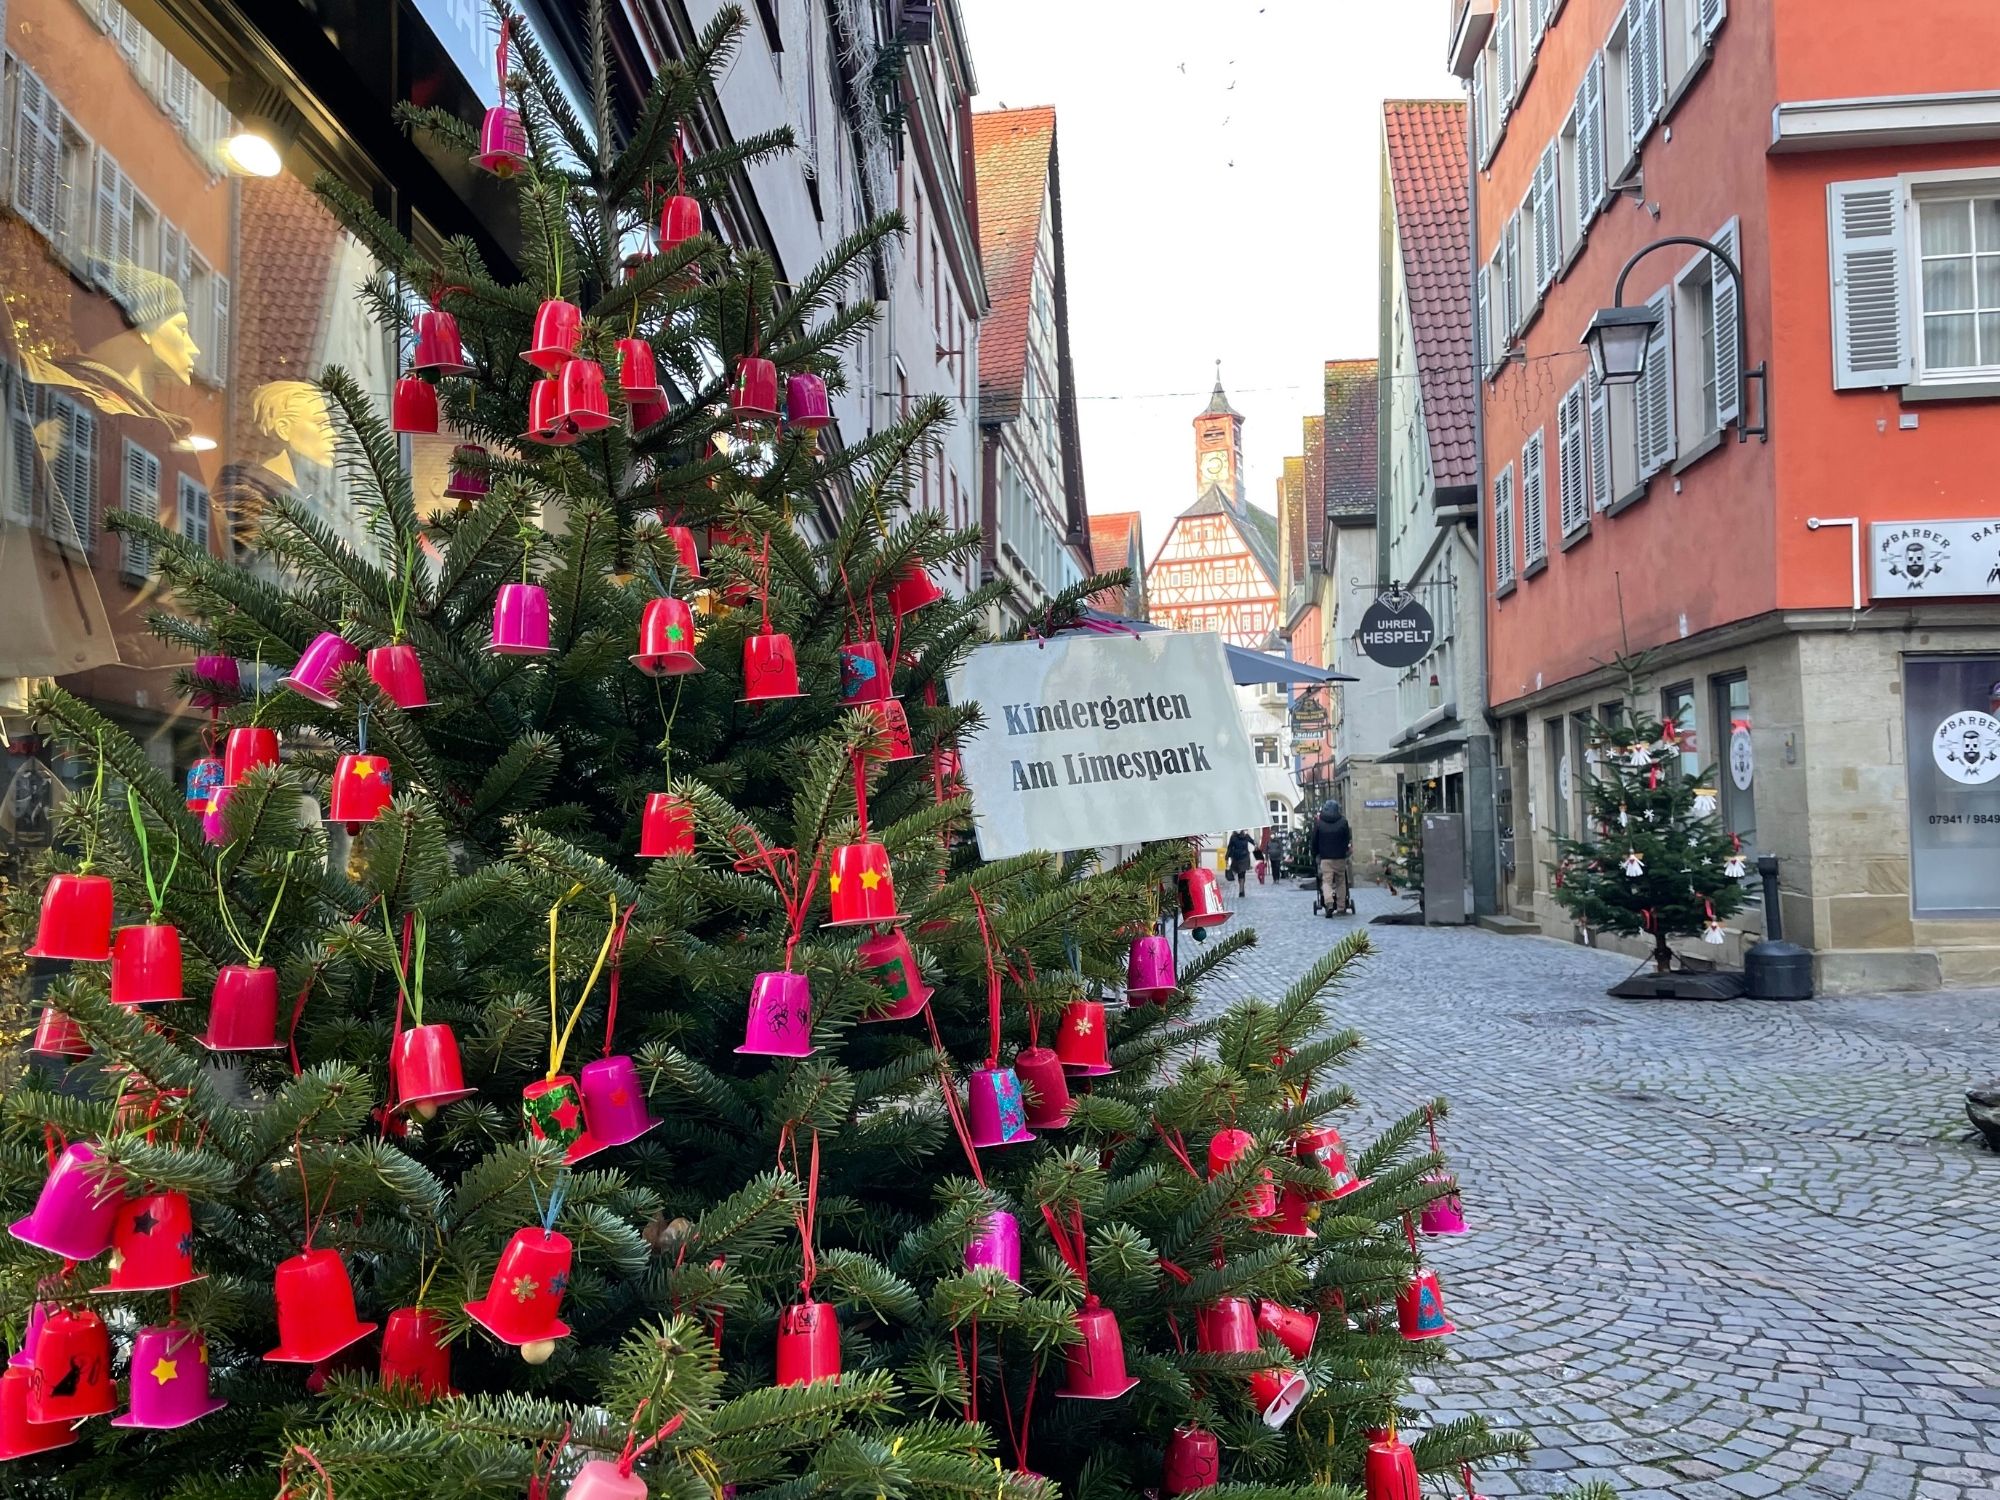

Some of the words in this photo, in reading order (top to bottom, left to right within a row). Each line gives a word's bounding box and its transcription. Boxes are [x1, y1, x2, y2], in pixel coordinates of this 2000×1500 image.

[1890, 528, 1951, 549] BARBER
[1377, 619, 1416, 629] UHREN
[1363, 630, 1431, 644] HESPELT
[1002, 692, 1192, 736] Kindergarten
[1011, 759, 1058, 791] Am
[1062, 742, 1212, 785] Limespark
[1929, 815, 1962, 824] 07941
